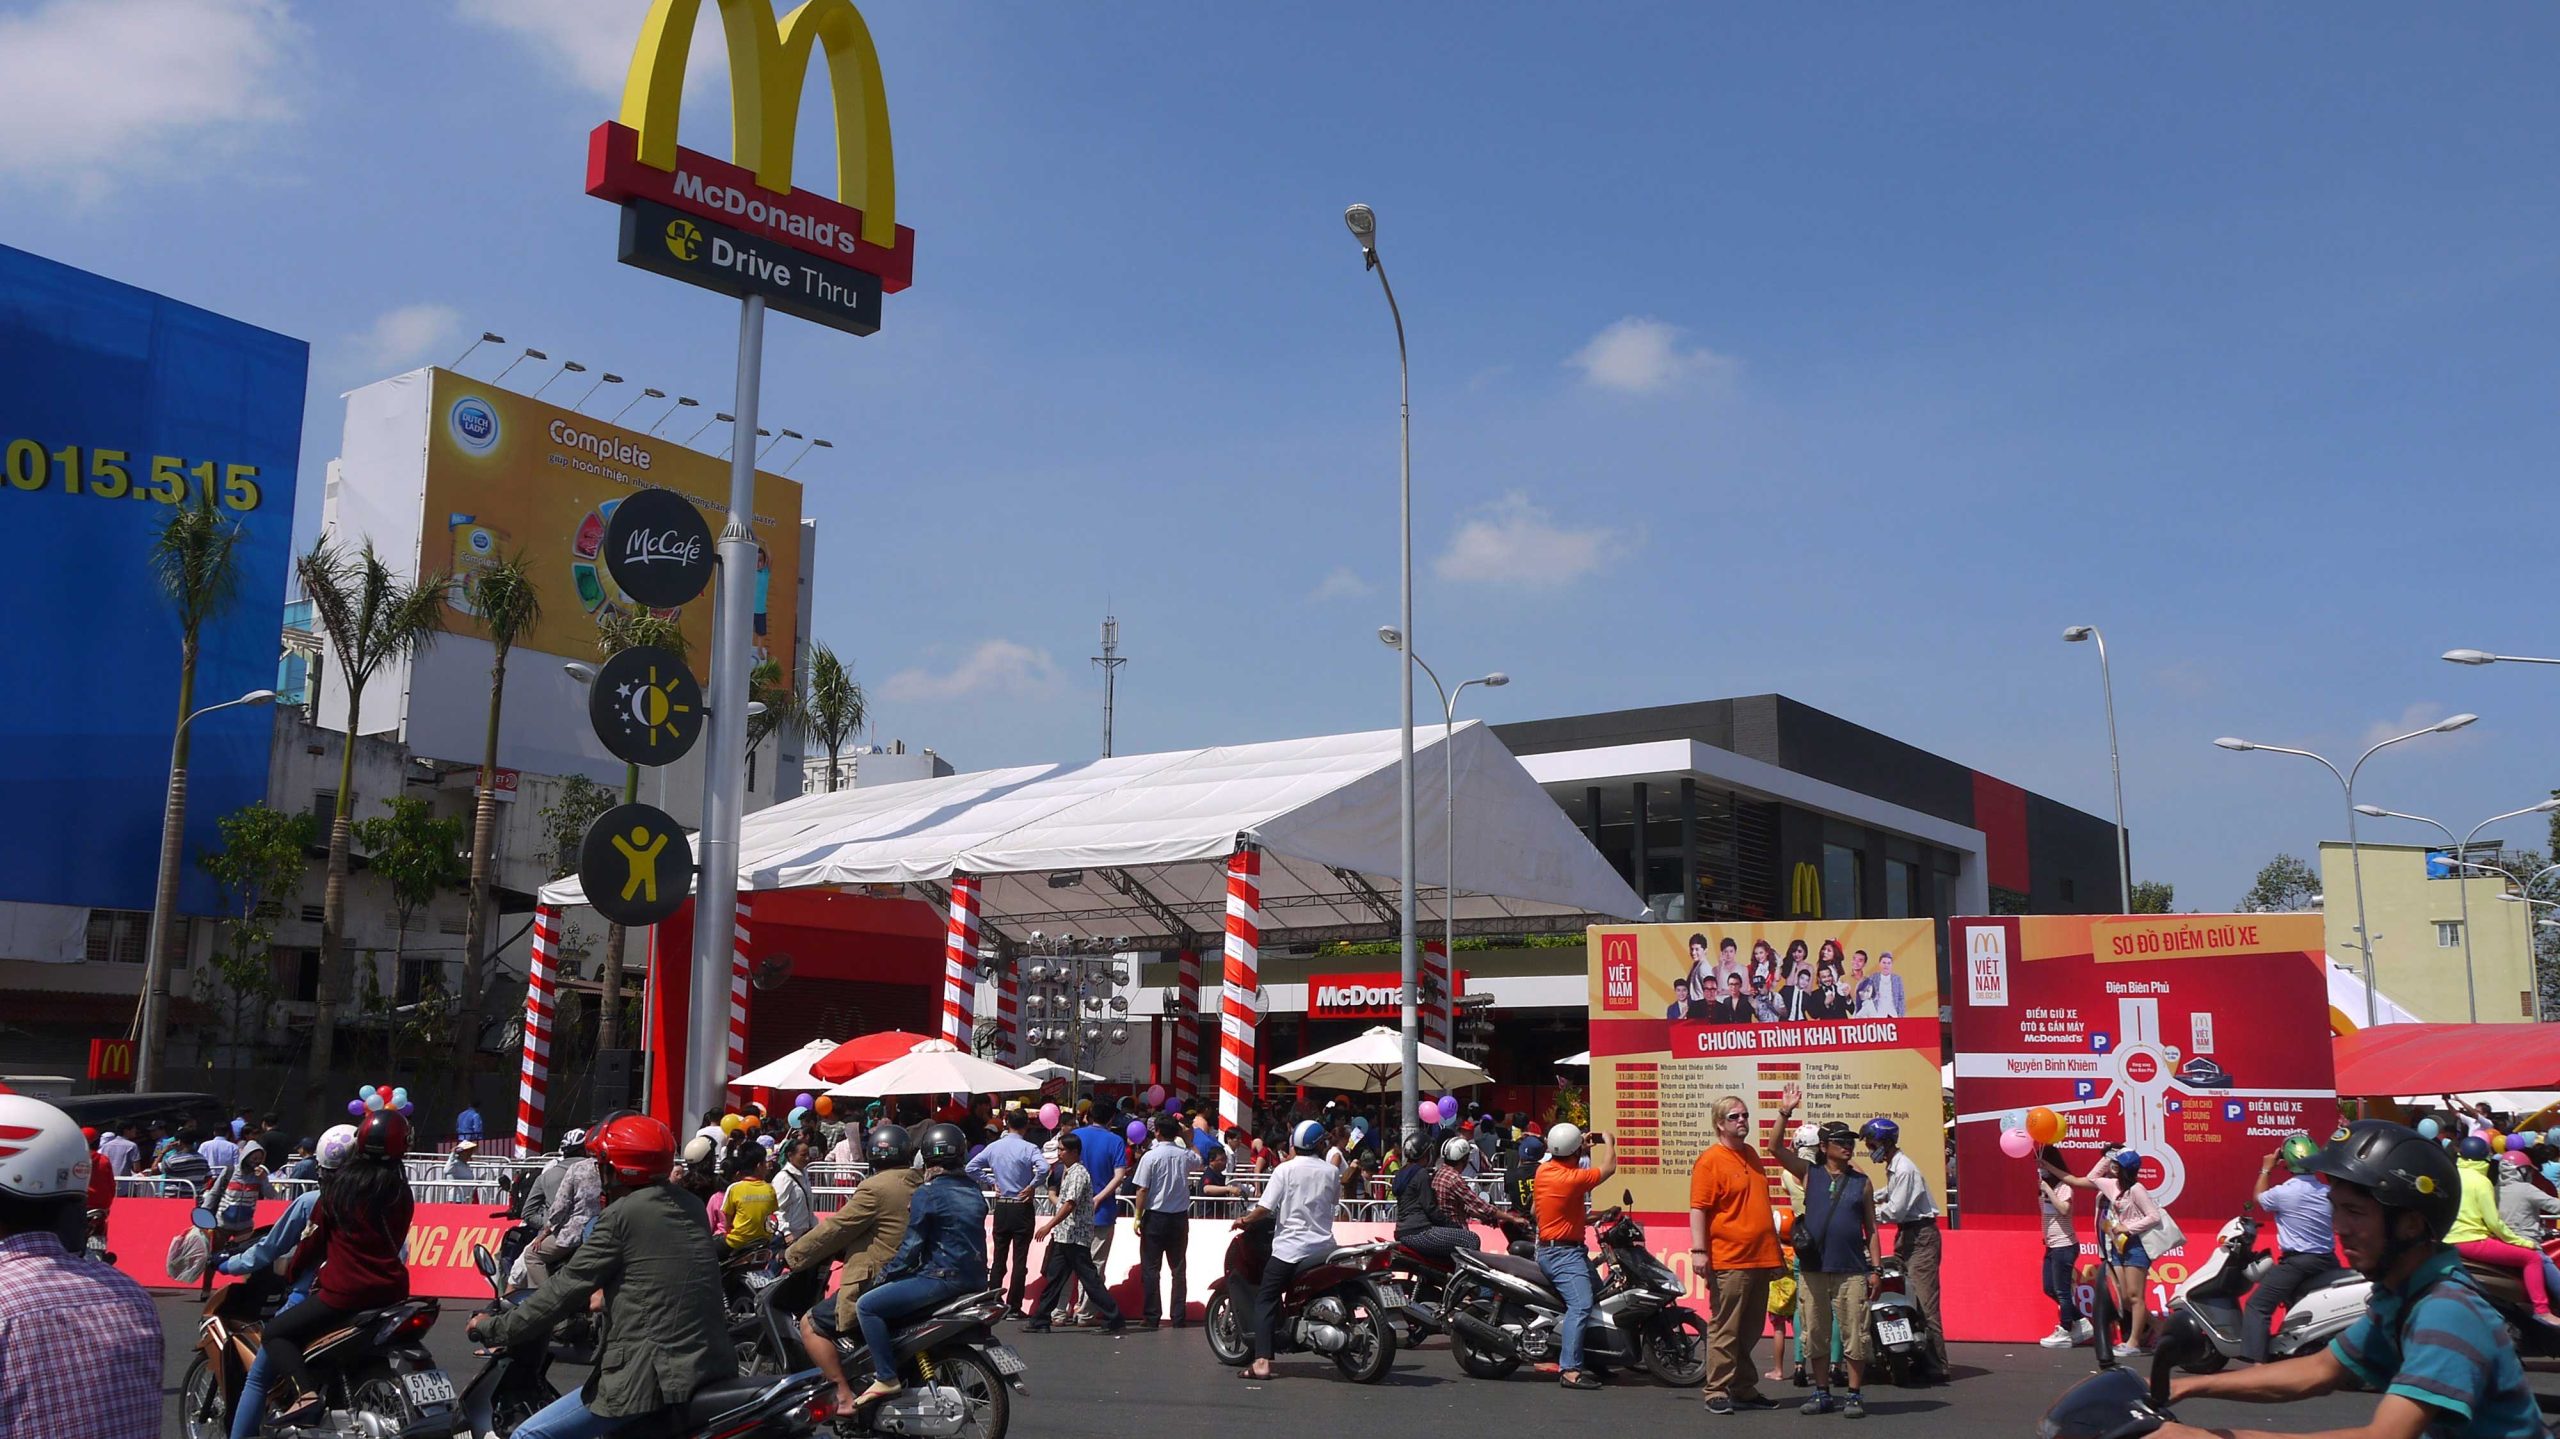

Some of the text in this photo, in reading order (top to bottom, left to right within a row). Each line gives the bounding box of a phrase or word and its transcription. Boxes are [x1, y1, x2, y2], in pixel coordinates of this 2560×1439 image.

[673, 171, 855, 253] McDonald's
[712, 238, 857, 308] Drive Thru
[462, 413, 488, 428] DUTCH
[465, 422, 485, 434] LADY
[550, 420, 651, 469] Complete
[624, 528, 701, 566] McCafé
[2113, 924, 2259, 955] SƠ ĐỒ ĐIỂM GIỮ XE
[1609, 963, 1632, 983] VIỆT
[1975, 957, 1999, 975] VIỆT
[1609, 981, 1633, 997] NAM
[1975, 976, 2000, 991] NAM
[2106, 980, 2170, 993] Điện Biên Phủ
[1316, 985, 1426, 1008] McDona
[2026, 1006, 2078, 1019] ĐIỂM GIỮ XE
[2039, 1022, 2046, 1032] &
[2067, 1021, 2085, 1032] MÁY
[1698, 1022, 1897, 1051] CHƯƠNG TRÌNH KHAI TRƯƠNG
[2024, 1034, 2083, 1042] McDonald's
[2008, 1058, 2042, 1073] Nguyễn
[2068, 1059, 2098, 1071] Khiêm
[2249, 1099, 2303, 1112] ĐIỂM GIỮ XE
[2096, 1115, 2107, 1124] XE
[2277, 1114, 2295, 1125] MÁY
[2082, 1128, 2100, 1138] MÁY
[1885, 1330, 1909, 1343] 5130
